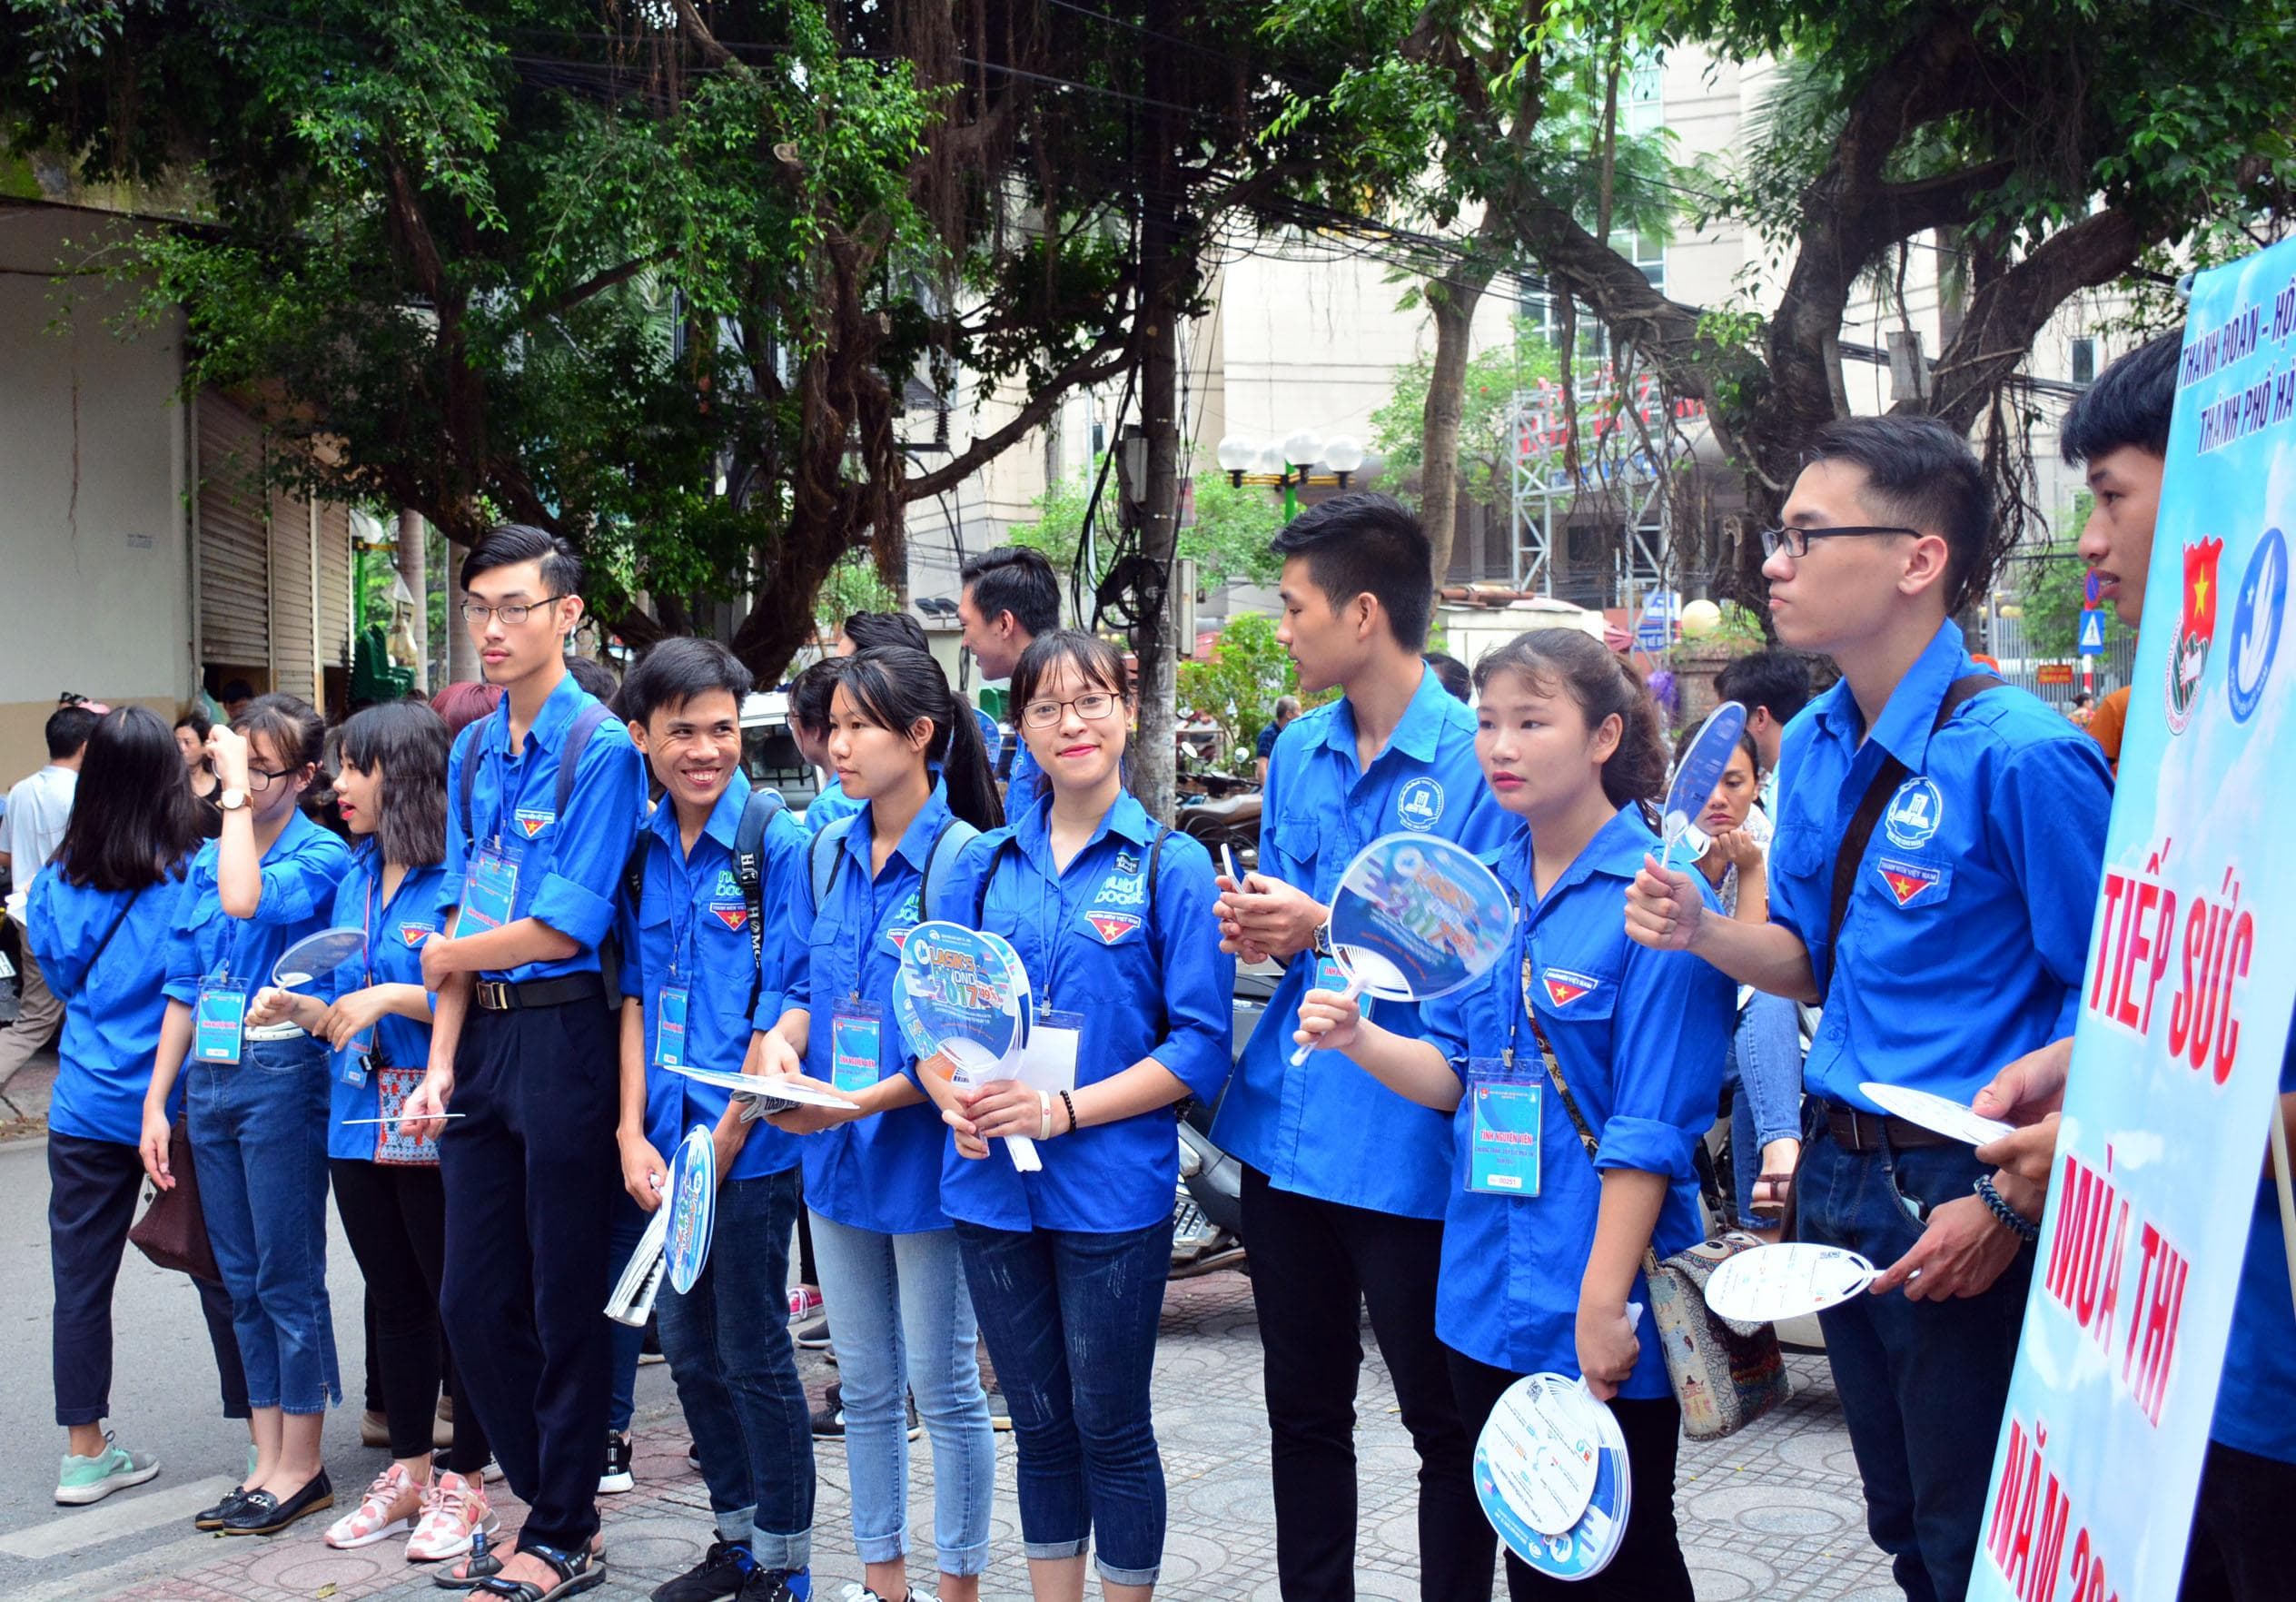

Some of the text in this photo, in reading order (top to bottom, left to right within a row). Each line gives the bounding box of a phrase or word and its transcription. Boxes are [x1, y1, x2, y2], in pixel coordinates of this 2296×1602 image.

[2180, 329, 2220, 388] THÀNH
[2221, 302, 2261, 368] ĐOÀN
[2271, 277, 2296, 349] HỘ
[2198, 392, 2242, 453] THÀNH
[2241, 361, 2276, 436] PHỐ
[935, 979, 978, 1008] 2017
[2089, 836, 2254, 1085] TIẾP SỨC
[2045, 1142, 2189, 1429] MÙA THI
[1987, 1418, 2070, 1602] NĂM
